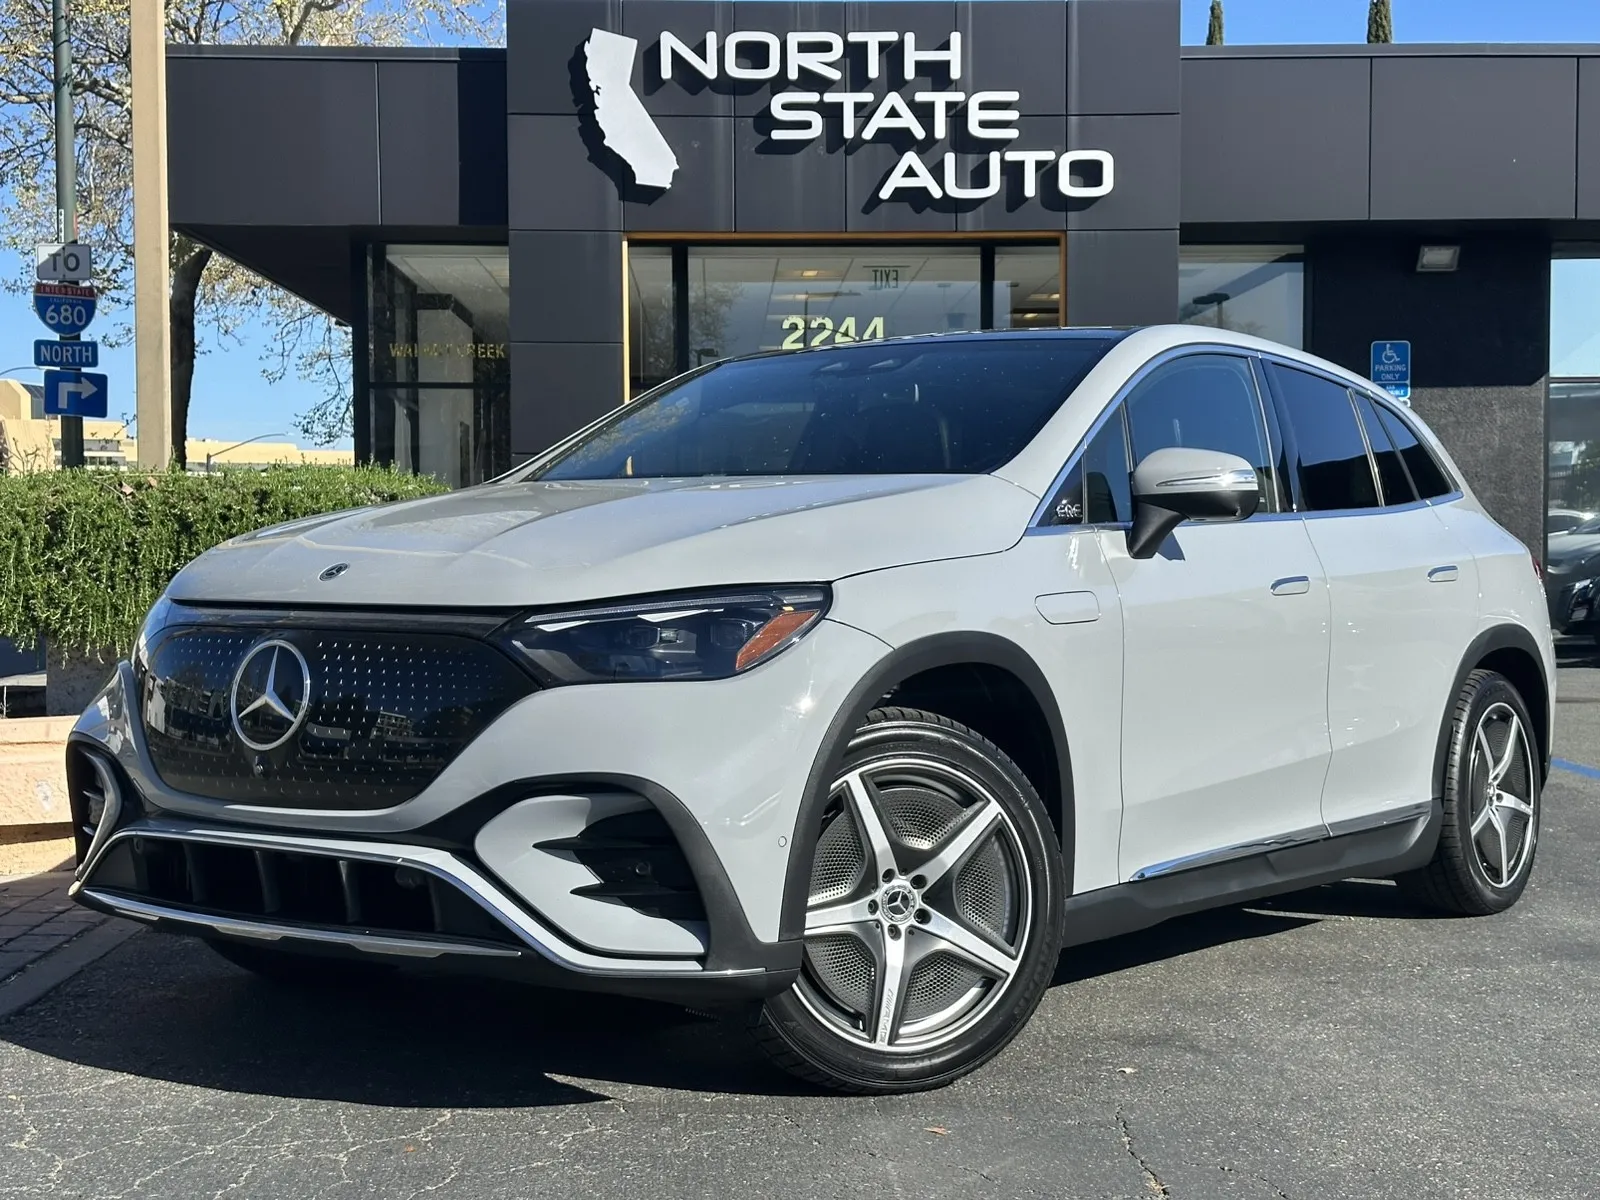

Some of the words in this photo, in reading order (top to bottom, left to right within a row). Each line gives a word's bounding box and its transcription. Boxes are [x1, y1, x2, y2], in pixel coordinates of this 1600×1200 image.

[660, 31, 962, 81] NORTH
[770, 91, 1020, 140] STATE
[878, 150, 1115, 200] AUTO
[48, 252, 80, 272] TO
[40, 286, 91, 297] INTERSTATE
[45, 305, 86, 326] 680
[782, 314, 884, 350] 2244
[40, 345, 92, 362] NORTH
[1375, 364, 1406, 372] PARKING
[1381, 373, 1400, 381] ONLY
